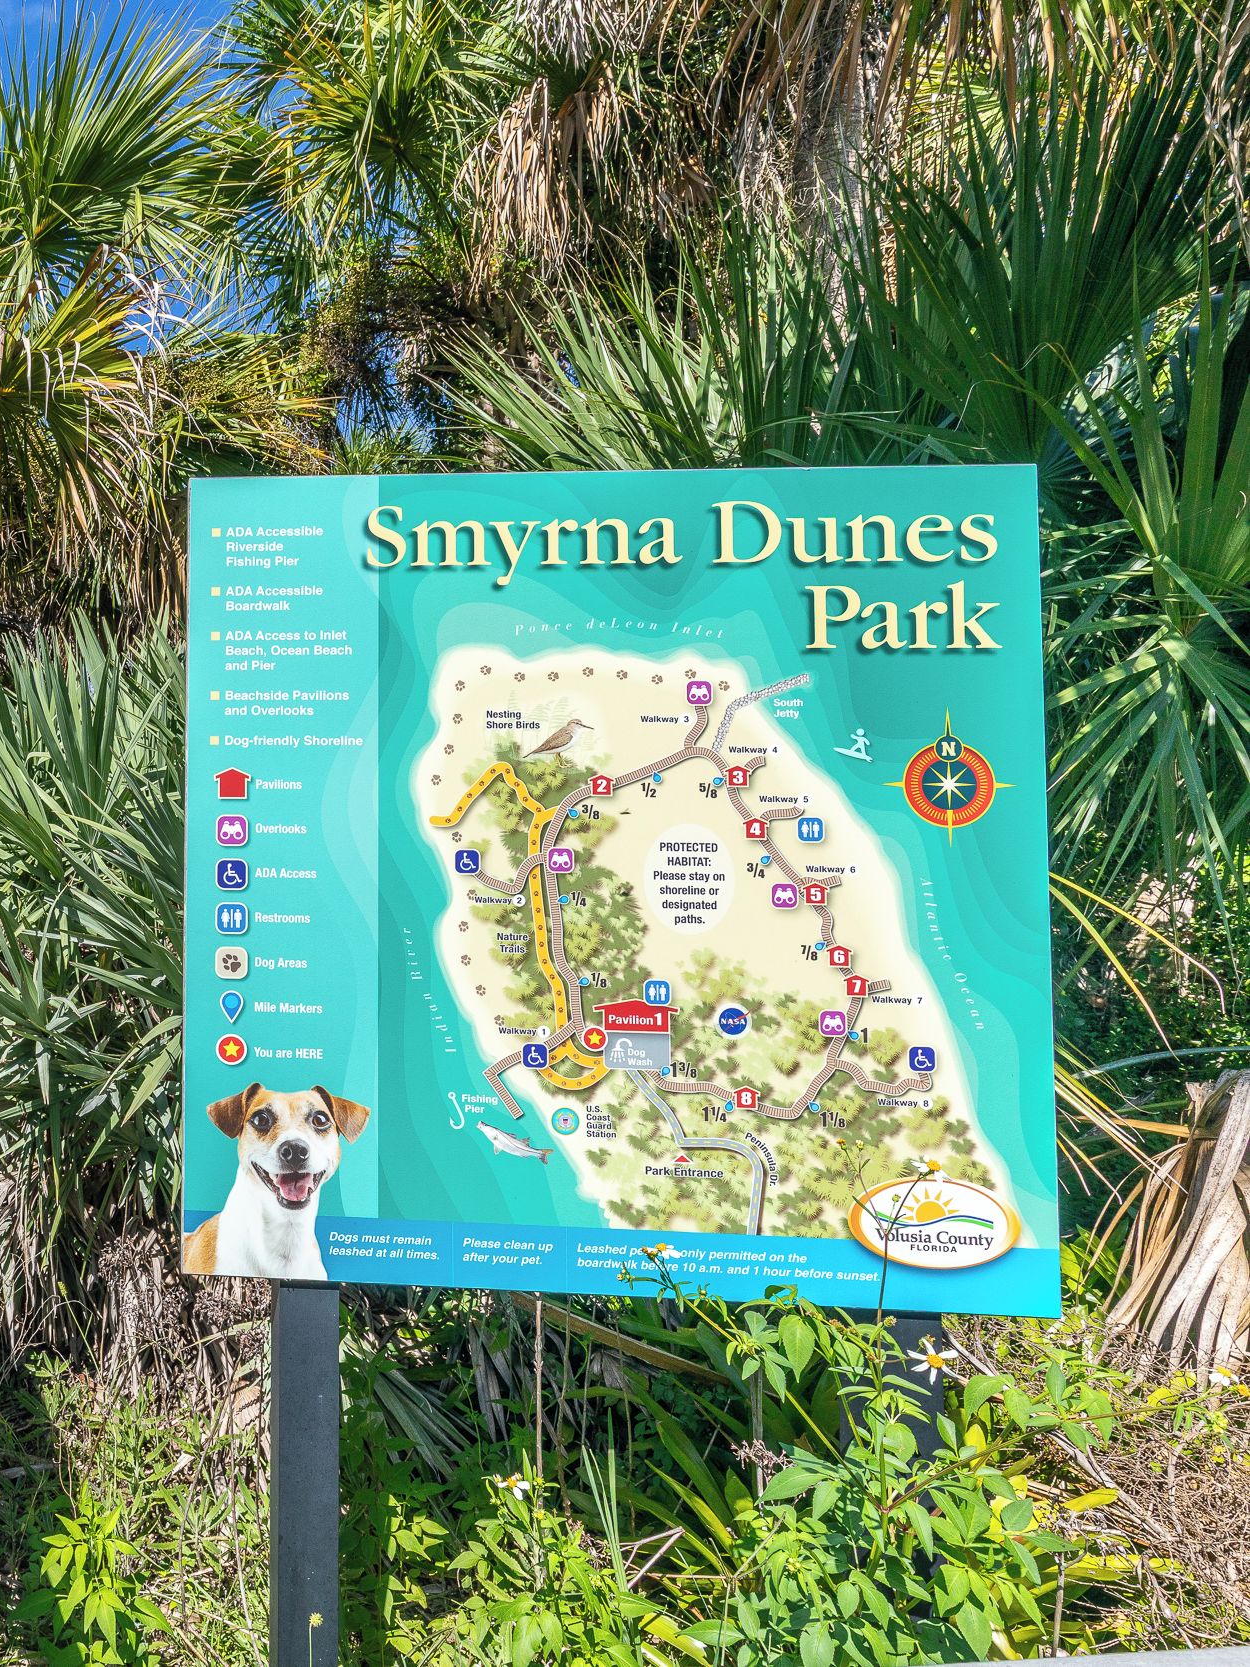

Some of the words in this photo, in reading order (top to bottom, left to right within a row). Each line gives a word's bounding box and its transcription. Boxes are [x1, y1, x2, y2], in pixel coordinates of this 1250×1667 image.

[226, 527, 253, 537] ADA
[256, 526, 324, 537] Accessible
[226, 541, 284, 552] Riverside
[366, 505, 682, 585] Smyrna
[712, 501, 998, 564] Dunes
[226, 556, 271, 568] Fishing
[275, 556, 299, 567] Pier
[225, 586, 253, 596] ADA
[256, 585, 324, 596] Accessible
[225, 601, 291, 611] Boardwalk
[805, 580, 1002, 649] Park
[514, 622, 573, 636] Ponce
[586, 617, 658, 631] deLeon
[671, 622, 725, 638] Inlet
[225, 631, 253, 641] ADA
[255, 630, 301, 641] Access
[304, 631, 316, 641] to
[319, 630, 347, 641] Inlet
[225, 646, 267, 657] Beach,
[271, 645, 310, 656] Ocean
[313, 645, 353, 656] Beach
[225, 661, 248, 671] and
[251, 661, 276, 671] Pier
[225, 690, 289, 701] Beachside
[292, 690, 350, 701] Pavilions
[773, 698, 804, 707] South
[224, 706, 248, 716] and
[251, 705, 314, 716] Overlooks
[486, 710, 522, 721] Nesting
[773, 708, 800, 719] Jetty
[486, 720, 513, 730] Shore
[515, 720, 541, 730] Birds
[640, 715, 679, 725] Walkway
[683, 715, 690, 724] 3
[224, 735, 300, 748] Dog-friendly
[304, 735, 364, 747] Shoreline
[728, 745, 768, 755] Walkway
[772, 745, 778, 754] 4
[941, 741, 956, 757] N
[733, 771, 744, 784] 3
[255, 778, 303, 790] Pavilions
[597, 780, 607, 793] 2
[641, 783, 657, 798] 1/2
[699, 783, 718, 799] 5/8
[759, 795, 799, 805] Walkway
[803, 795, 809, 804] 5
[582, 805, 600, 820] 3/8
[255, 823, 307, 834] Overlooks
[750, 823, 761, 835] 4
[659, 842, 718, 852] PROTECTED
[667, 857, 711, 866] HABITAT:
[255, 868, 277, 879] ADA
[279, 868, 317, 879] Access
[746, 863, 765, 878] 3/4
[805, 865, 846, 875] Walkway
[850, 865, 856, 874] 6
[653, 871, 686, 881] Please
[689, 872, 710, 882] stay
[713, 873, 725, 881] on
[659, 885, 706, 895] shoreline
[709, 887, 719, 895] or
[810, 888, 821, 901] 5
[474, 896, 512, 906] Walkway
[516, 896, 522, 905] 2
[571, 892, 586, 907] 1/4
[662, 900, 717, 911] designated
[255, 912, 311, 924] Restrooms
[674, 914, 705, 925] paths.
[920, 877, 952, 960] Atlantic
[497, 933, 528, 942] Nature
[403, 927, 423, 980] River
[500, 944, 525, 953] Trails
[801, 945, 818, 961] 7/8
[255, 957, 275, 969] Dog
[277, 957, 307, 969] Areas
[833, 950, 845, 964] 6
[591, 972, 607, 988] 1/8
[852, 980, 862, 993] 7
[871, 996, 912, 1005] Walkway
[917, 996, 923, 1004] 7
[954, 972, 984, 1030] Ocean
[254, 1002, 277, 1013] Mile
[279, 1002, 323, 1014] Markers
[423, 993, 456, 1052] Indian
[498, 1027, 538, 1037] Walkway
[541, 1028, 546, 1036] 1
[861, 1028, 869, 1043] 1
[254, 1047, 273, 1059] You
[275, 1049, 293, 1059] are
[296, 1047, 323, 1060] HERE
[628, 1048, 646, 1058] Dog
[628, 1058, 653, 1066] Wash
[462, 1094, 499, 1105] Fishing
[741, 1091, 752, 1105] 8
[878, 1098, 918, 1108] Walkway
[923, 1099, 929, 1107] 8
[465, 1104, 485, 1113] Pier
[586, 1105, 603, 1113] U.S.
[586, 1114, 611, 1122] Coast
[586, 1122, 612, 1130] Guard
[586, 1130, 617, 1138] Station
[745, 1132, 777, 1172] Peninsula
[770, 1174, 778, 1187] Dr.
[645, 1166, 671, 1177] Park
[673, 1167, 724, 1179] Entrance
[329, 1232, 359, 1244] Dogs
[362, 1233, 390, 1244] must
[393, 1235, 432, 1246] remain
[936, 1231, 994, 1250] County
[463, 1238, 501, 1249] Please
[503, 1239, 536, 1251] clean
[537, 1242, 553, 1253] up
[910, 1243, 958, 1253] FLORIDA
[329, 1246, 373, 1257] leashed
[376, 1248, 386, 1257] at
[388, 1247, 403, 1258] all
[405, 1249, 440, 1260] times.
[463, 1252, 489, 1263] after
[492, 1254, 518, 1265] your
[521, 1254, 543, 1266] pet.
[577, 1243, 627, 1255] Leashed
[680, 1250, 706, 1262] only
[709, 1250, 766, 1263] permitted
[769, 1254, 784, 1262] on
[787, 1252, 807, 1263] the
[683, 1262, 696, 1272] 10
[698, 1264, 723, 1274] a.m.
[727, 1265, 750, 1275] and
[753, 1265, 759, 1275] 1
[763, 1266, 791, 1277] hour
[794, 1267, 833, 1279] before
[836, 1270, 881, 1282] sunset.
